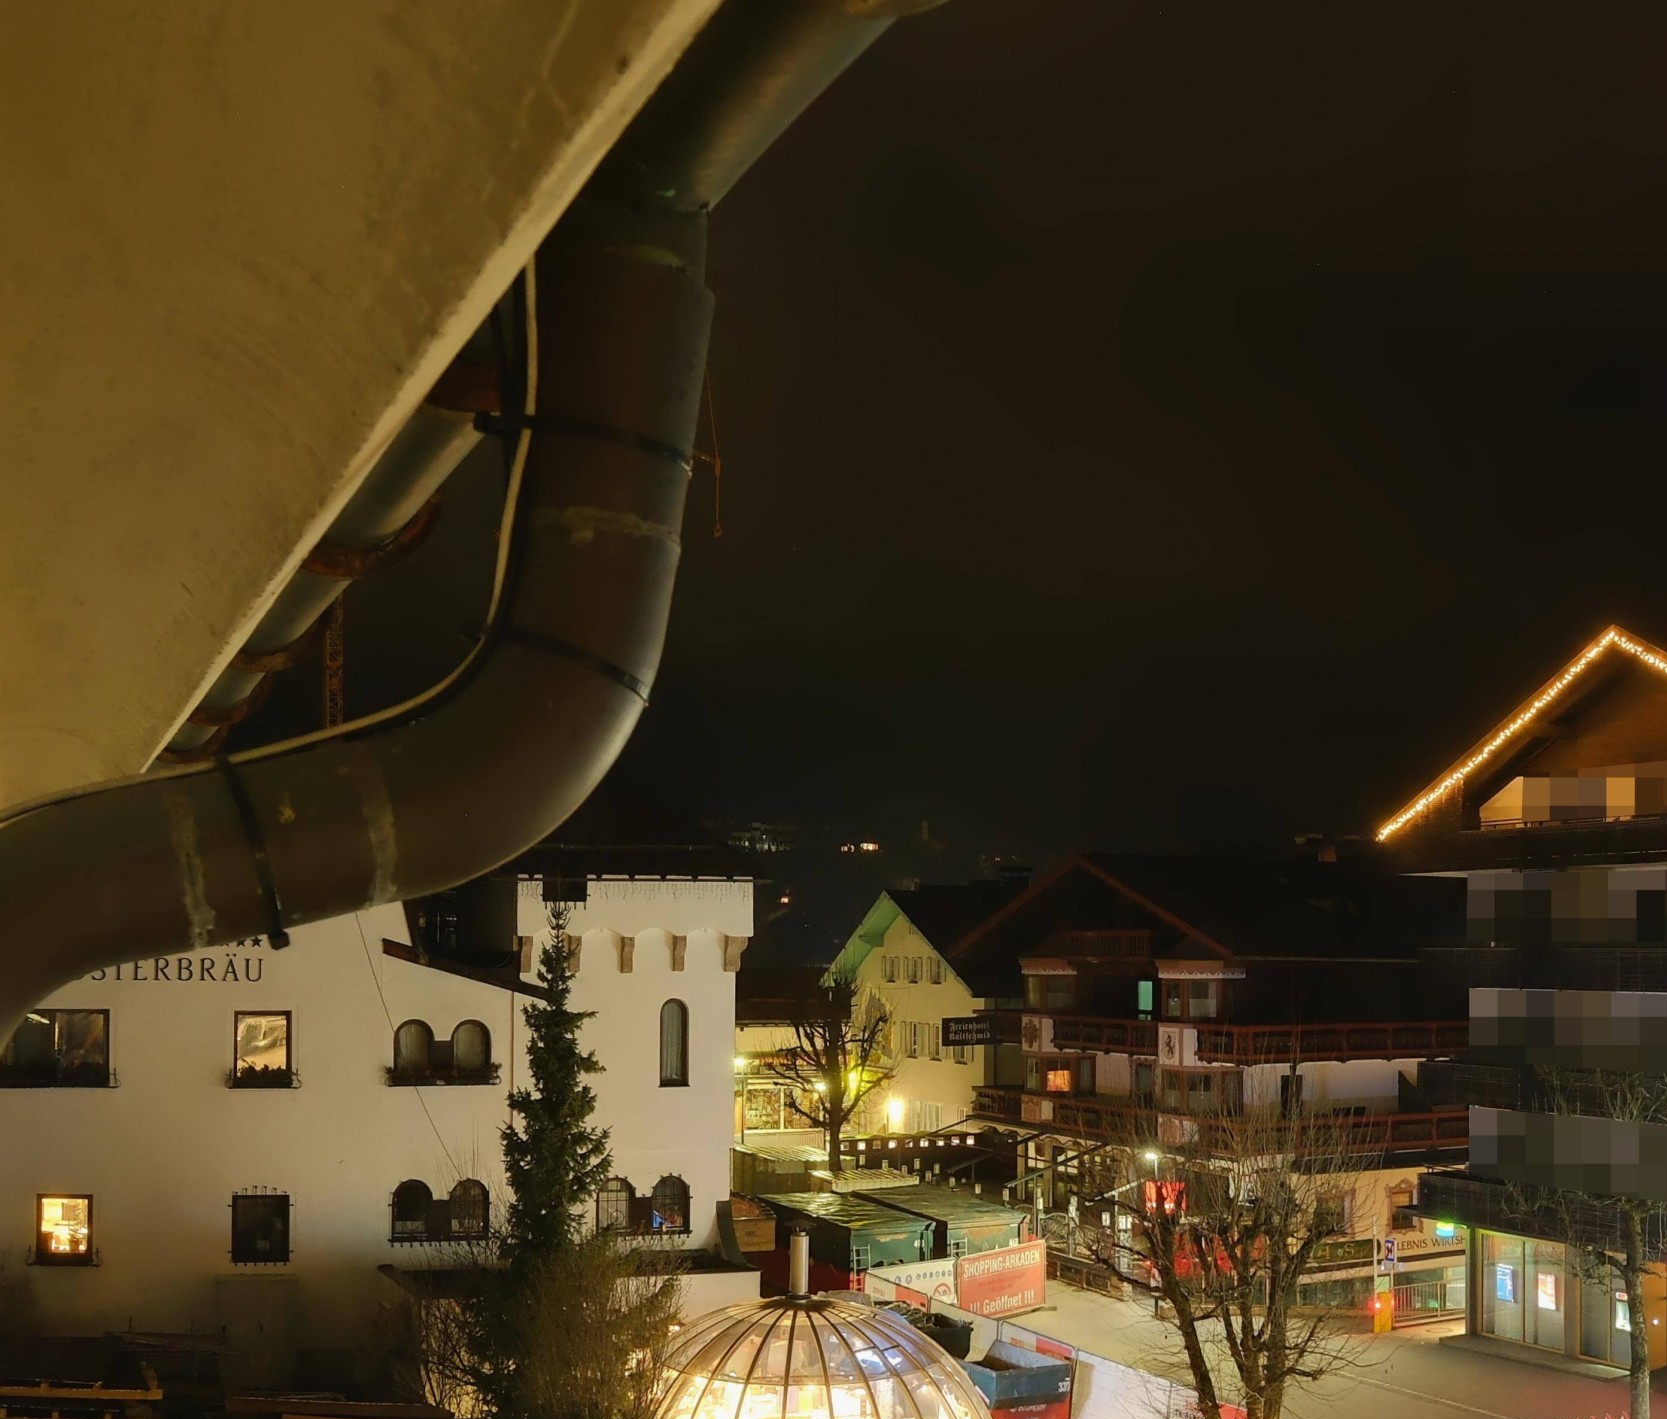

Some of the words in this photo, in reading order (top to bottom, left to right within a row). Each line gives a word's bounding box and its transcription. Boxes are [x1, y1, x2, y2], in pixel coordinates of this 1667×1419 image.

[74, 953, 264, 982] STERBRÄU
[1397, 1238, 1428, 1251] LEBNIS
[963, 1250, 1040, 1279] SHOPPING-ARKADEN
[983, 1293, 1022, 1313] Geöffnet
